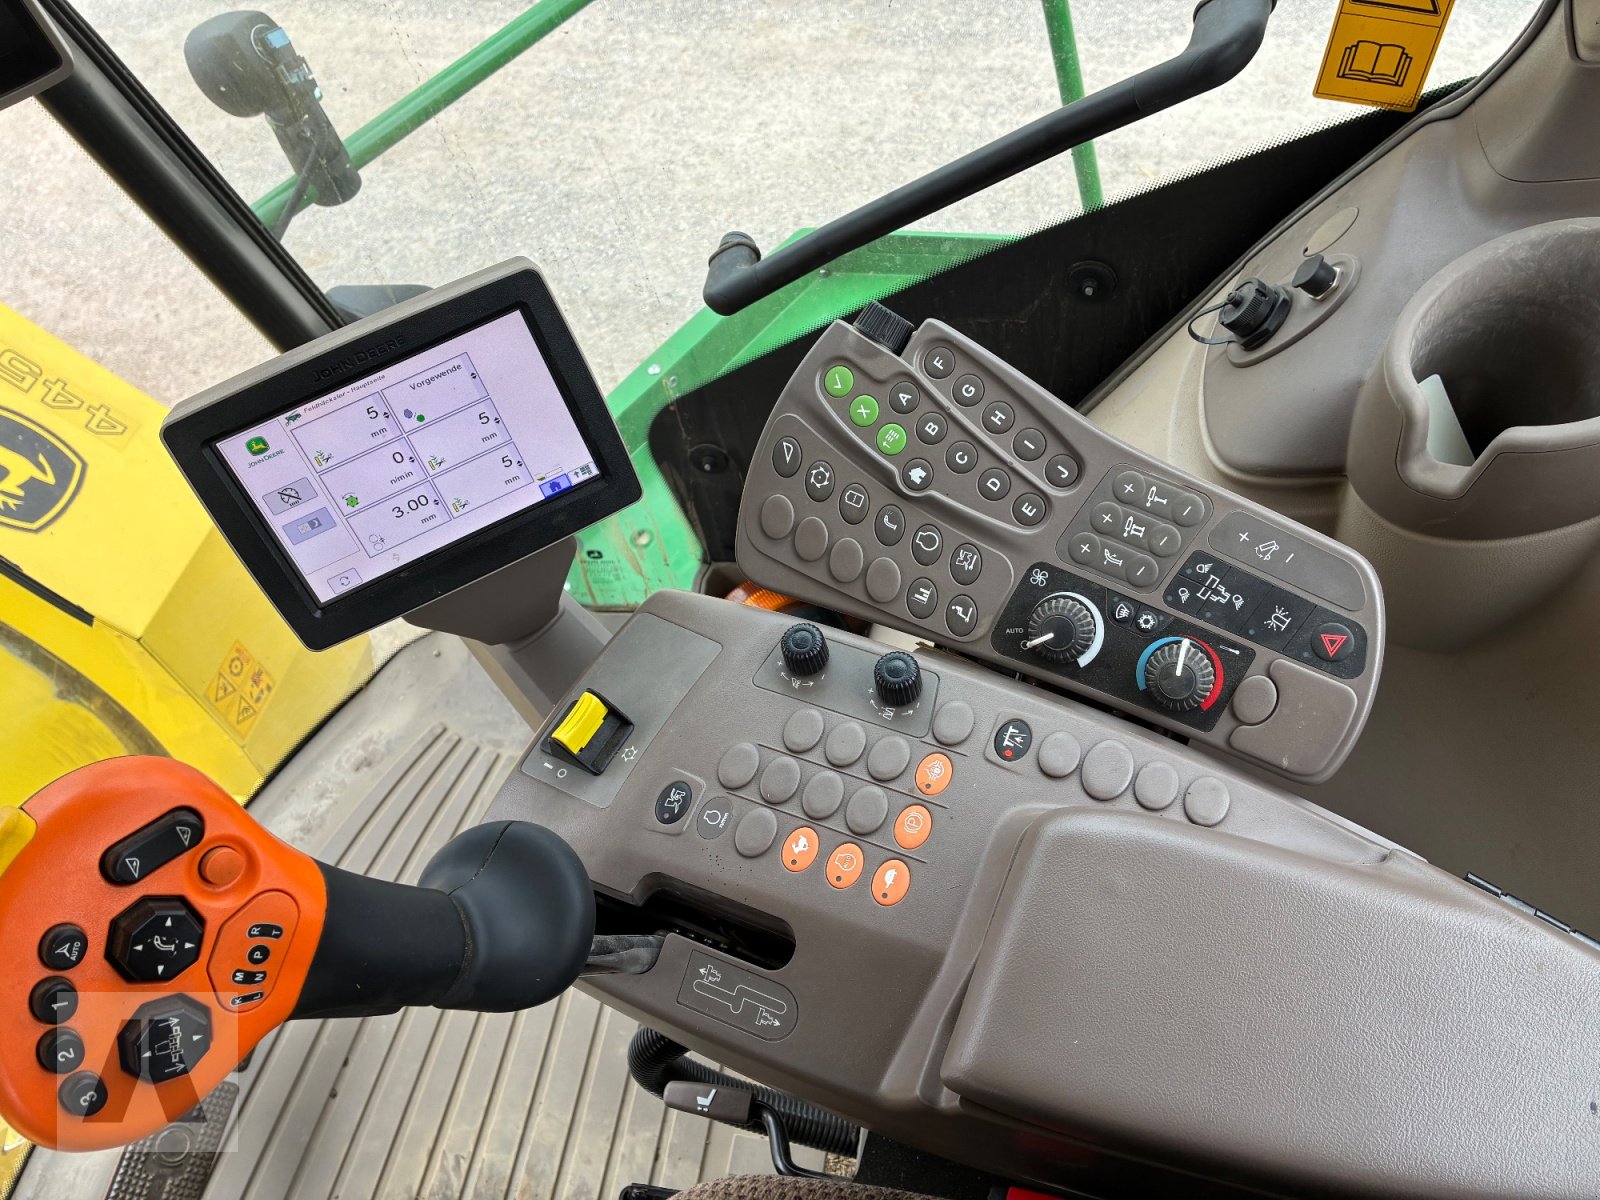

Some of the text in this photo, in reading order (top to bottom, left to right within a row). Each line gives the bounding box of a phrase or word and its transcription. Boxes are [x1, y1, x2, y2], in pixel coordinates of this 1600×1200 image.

[312, 337, 406, 382] JOHN DEERE
[933, 356, 944, 370] F
[409, 363, 462, 391] Vorgewende
[962, 384, 976, 397] G
[898, 392, 912, 406] A
[366, 405, 379, 420] 5
[478, 411, 490, 425] 5
[990, 410, 1006, 426] H
[370, 426, 388, 438] mm
[924, 422, 939, 436] B
[481, 432, 498, 443] mm
[248, 449, 285, 469] JOHN DEERE
[392, 451, 405, 464] 0
[501, 454, 513, 468] 5
[955, 452, 968, 465] C
[390, 470, 414, 485] n/min
[1057, 465, 1069, 479] J
[504, 474, 520, 486] mm
[986, 478, 1001, 491] D
[391, 494, 429, 518] 3.00
[1022, 502, 1037, 517] E
[420, 513, 437, 525] mm
[1005, 627, 1024, 635] AUTO
[250, 926, 261, 935] R
[271, 928, 281, 936] T
[70, 941, 81, 961] AUTO
[253, 950, 263, 959] P
[234, 972, 244, 981] M
[254, 973, 264, 981] N
[234, 997, 242, 1006] K
[252, 992, 261, 1000] L
[51, 1001, 69, 1010] 1
[57, 1047, 75, 1062] 2
[79, 1090, 98, 1106] 3
